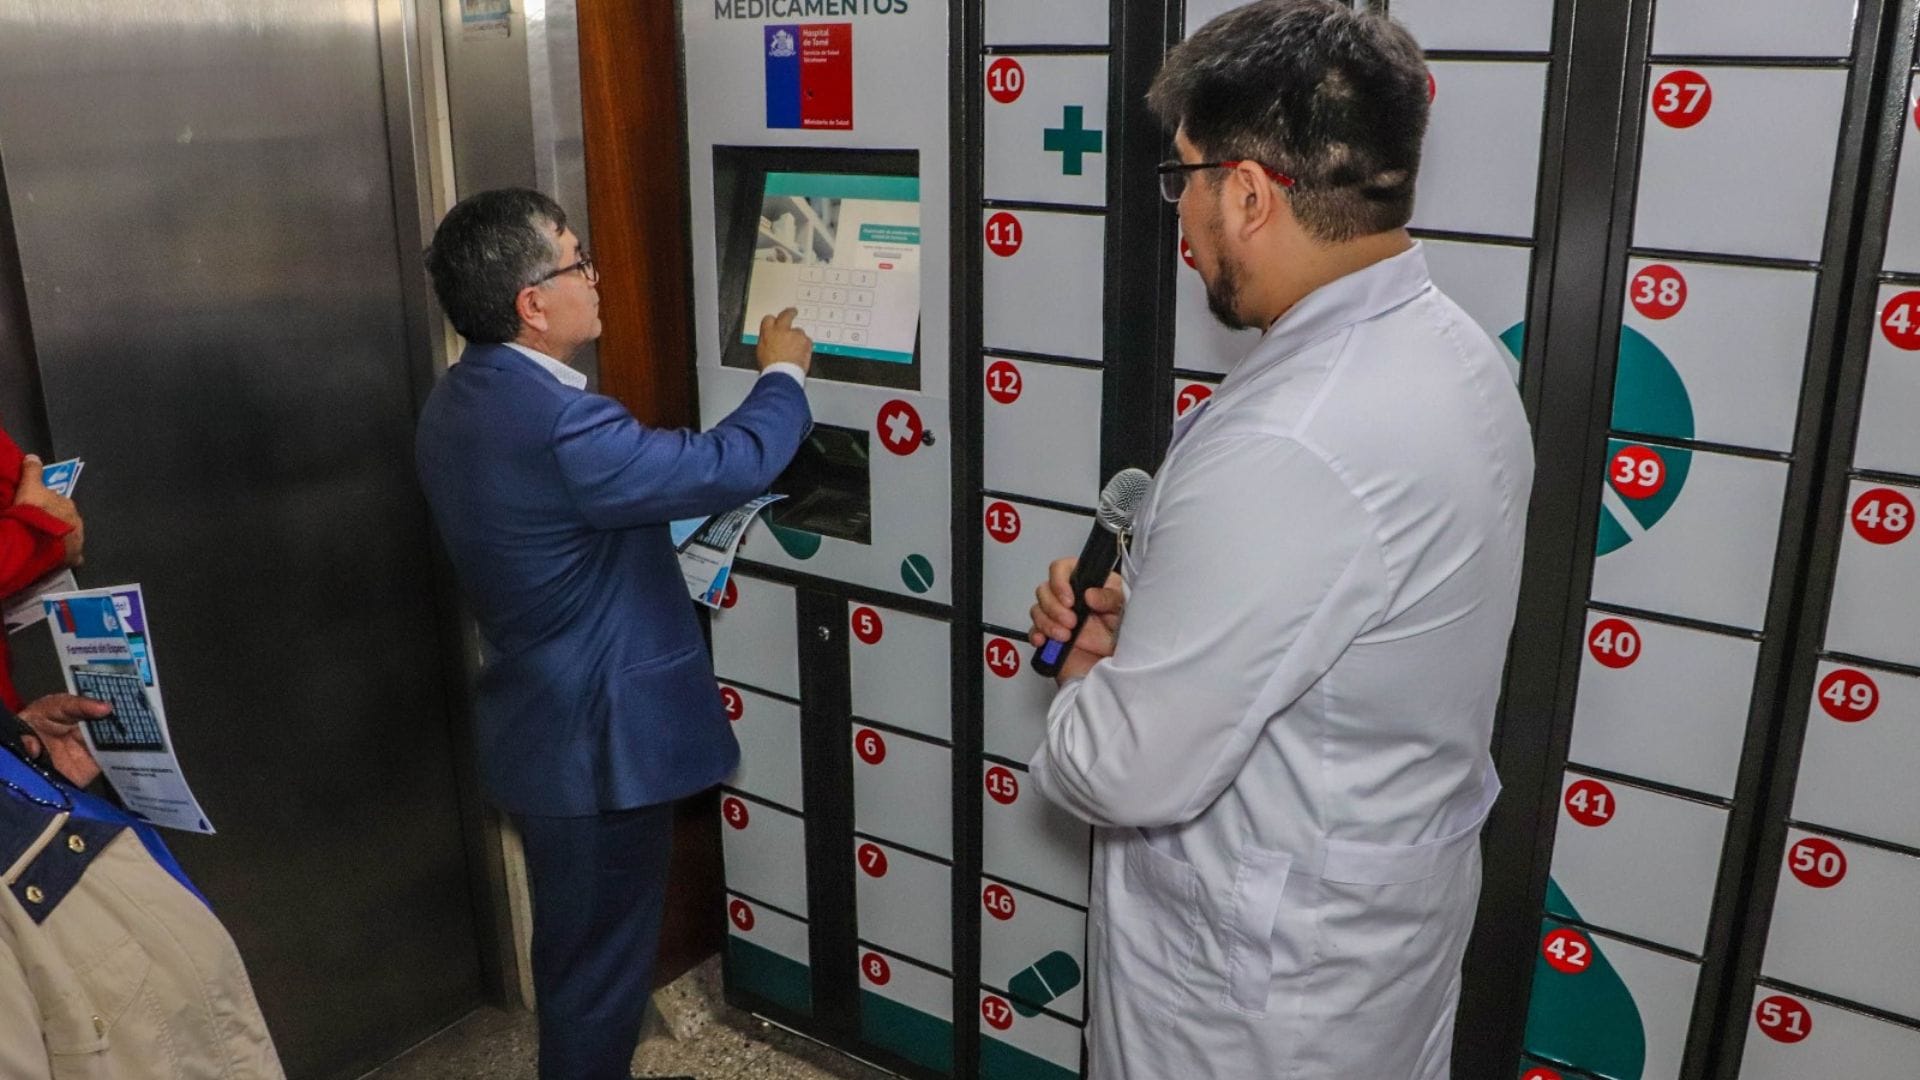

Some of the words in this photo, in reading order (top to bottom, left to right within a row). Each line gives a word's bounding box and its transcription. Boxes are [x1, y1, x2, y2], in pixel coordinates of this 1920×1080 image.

[714, 0, 908, 20] MEDICAMENTOS
[991, 67, 1021, 92] 10
[1658, 83, 1706, 114] 37
[989, 222, 1018, 246] 11
[1635, 275, 1681, 307] 38
[1885, 303, 1920, 336] 4
[990, 370, 1018, 394] 12
[1615, 455, 1660, 487] 39
[989, 509, 1017, 534] 13
[1856, 499, 1909, 532] 48
[860, 614, 874, 635] 5
[1593, 628, 1636, 658] 40
[989, 645, 1016, 670] 14
[724, 694, 736, 713] 2
[1823, 679, 1873, 711] 49
[864, 737, 877, 756] 6
[989, 773, 1015, 798] 15
[730, 803, 741, 822] 3
[1569, 788, 1609, 819] 41
[866, 850, 878, 869] 7
[1793, 845, 1841, 878] 50
[987, 890, 1012, 914] 16
[736, 907, 747, 924] 4
[1547, 936, 1587, 967] 42
[870, 959, 882, 978] 8
[985, 1001, 1010, 1024] 17
[1760, 1003, 1804, 1036] 51
